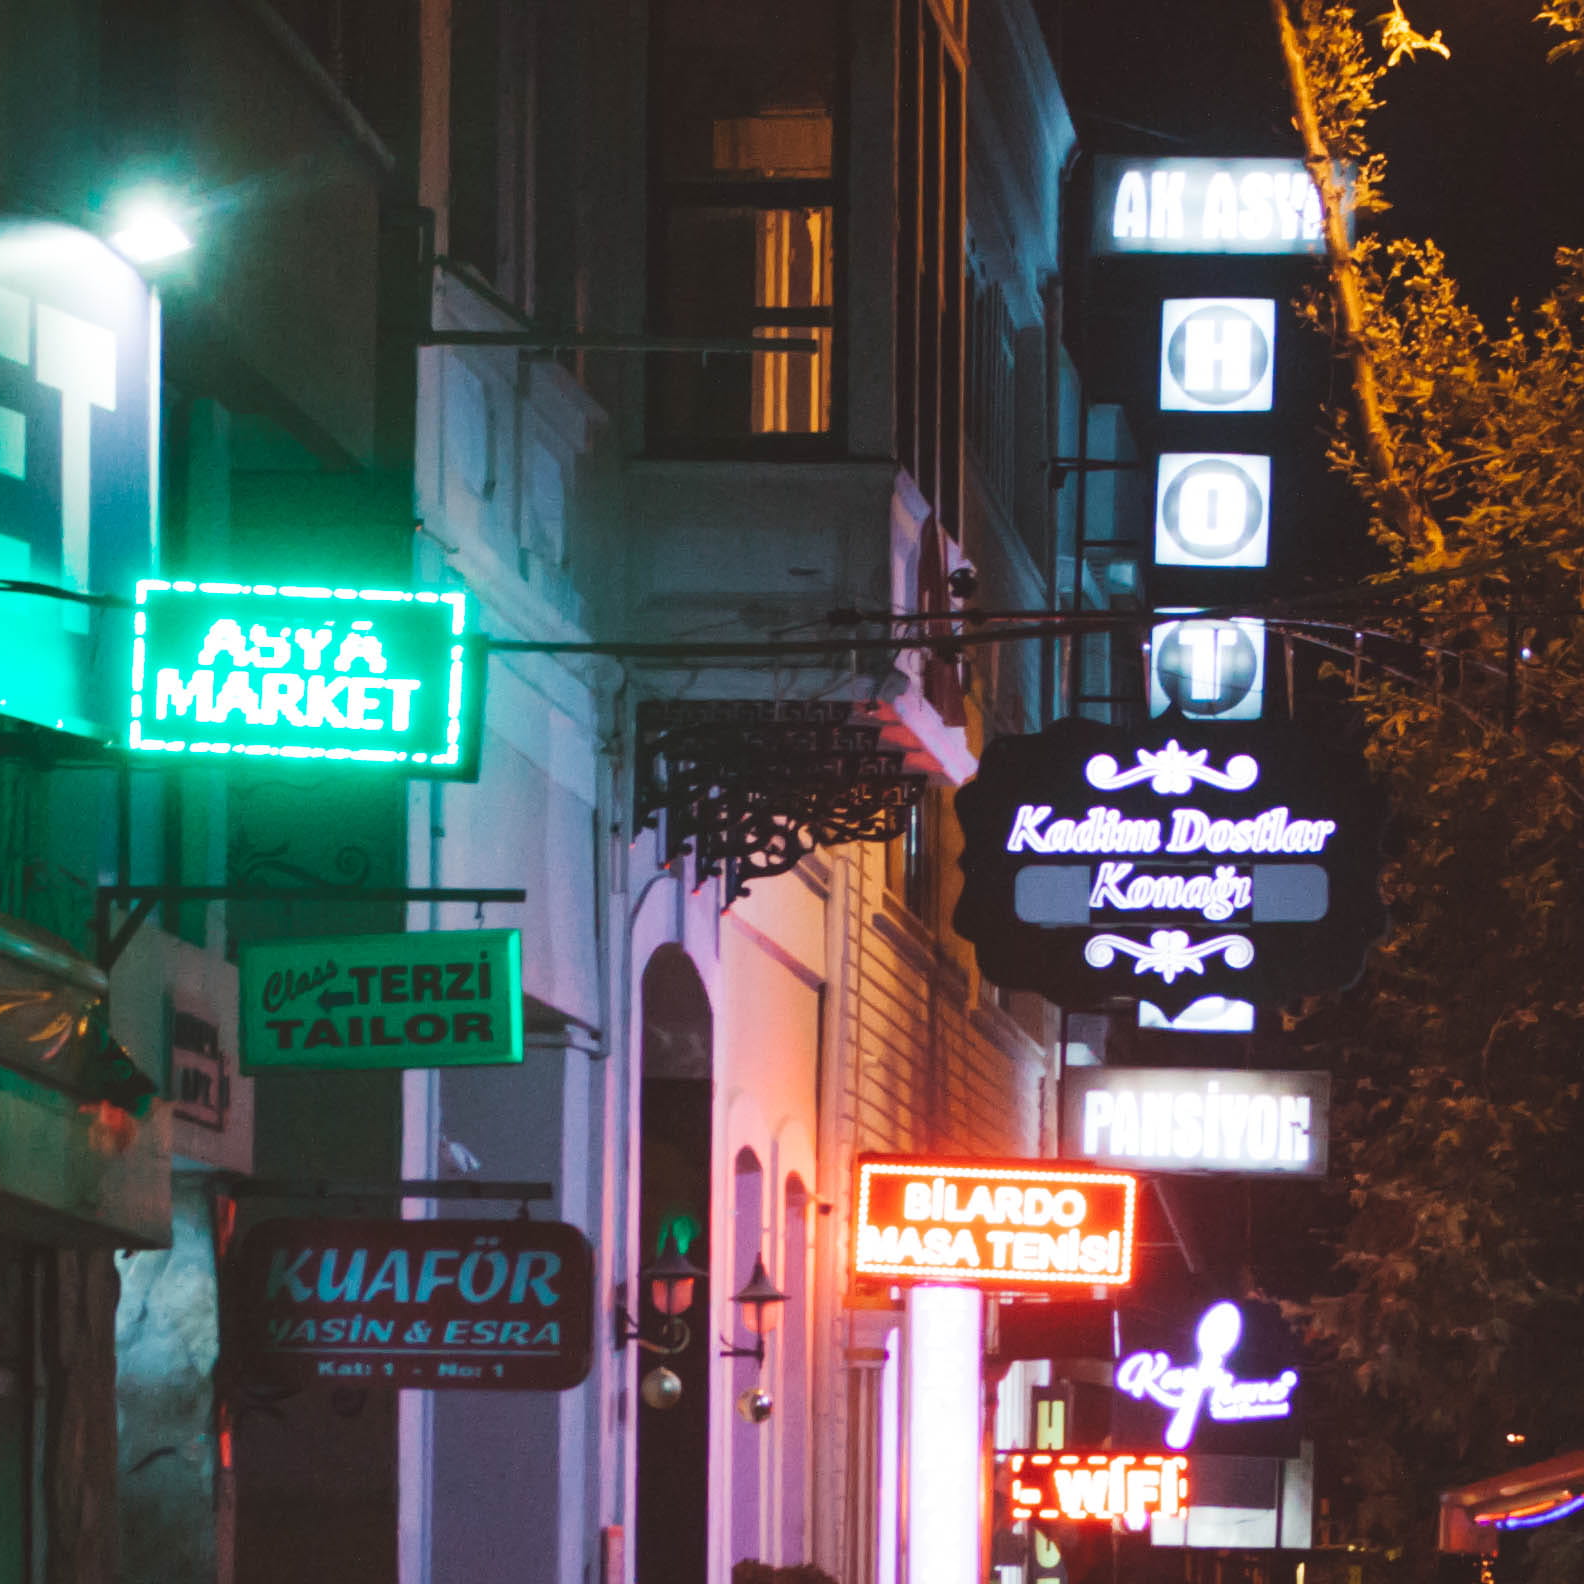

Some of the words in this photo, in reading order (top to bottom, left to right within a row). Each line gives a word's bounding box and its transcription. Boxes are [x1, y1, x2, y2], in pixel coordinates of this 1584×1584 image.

[197, 618, 388, 674] ASYA
[154, 667, 422, 732] MARKET
[1007, 804, 1162, 853] Kadim
[1165, 805, 1337, 853] Dostlar
[1089, 861, 1253, 922] Konağı
[347, 950, 491, 1005] TERZİ
[265, 1012, 494, 1050] TAILOR
[265, 1235, 563, 1307] KUAFÖR
[864, 1224, 981, 1267] MASA
[403, 1318, 432, 1345] &
[442, 1318, 561, 1346] ESRA
